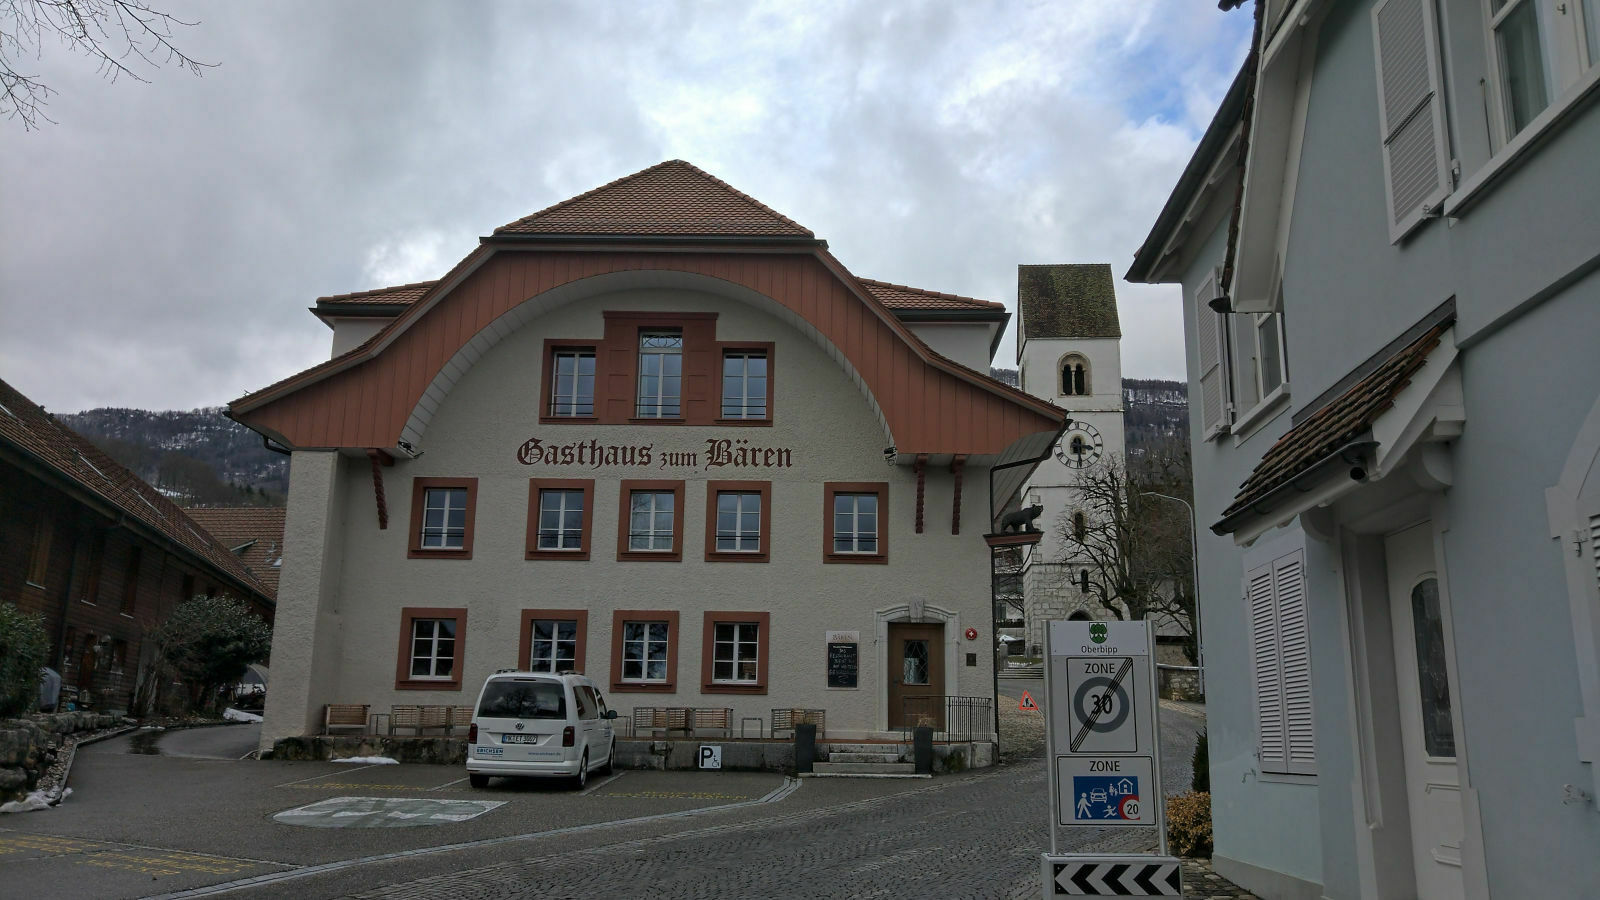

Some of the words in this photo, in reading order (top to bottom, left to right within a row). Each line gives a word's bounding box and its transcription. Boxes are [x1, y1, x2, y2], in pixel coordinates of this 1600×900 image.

[516, 437, 653, 471] Gasthaus
[659, 450, 698, 470] zum
[704, 438, 793, 471] Bären
[1081, 645, 1118, 654] Oberbipp
[1084, 662, 1116, 674] ZONE
[1091, 694, 1113, 714] 30
[701, 747, 714, 767] P
[1089, 760, 1121, 772] ZONE
[1126, 803, 1139, 815] 20
